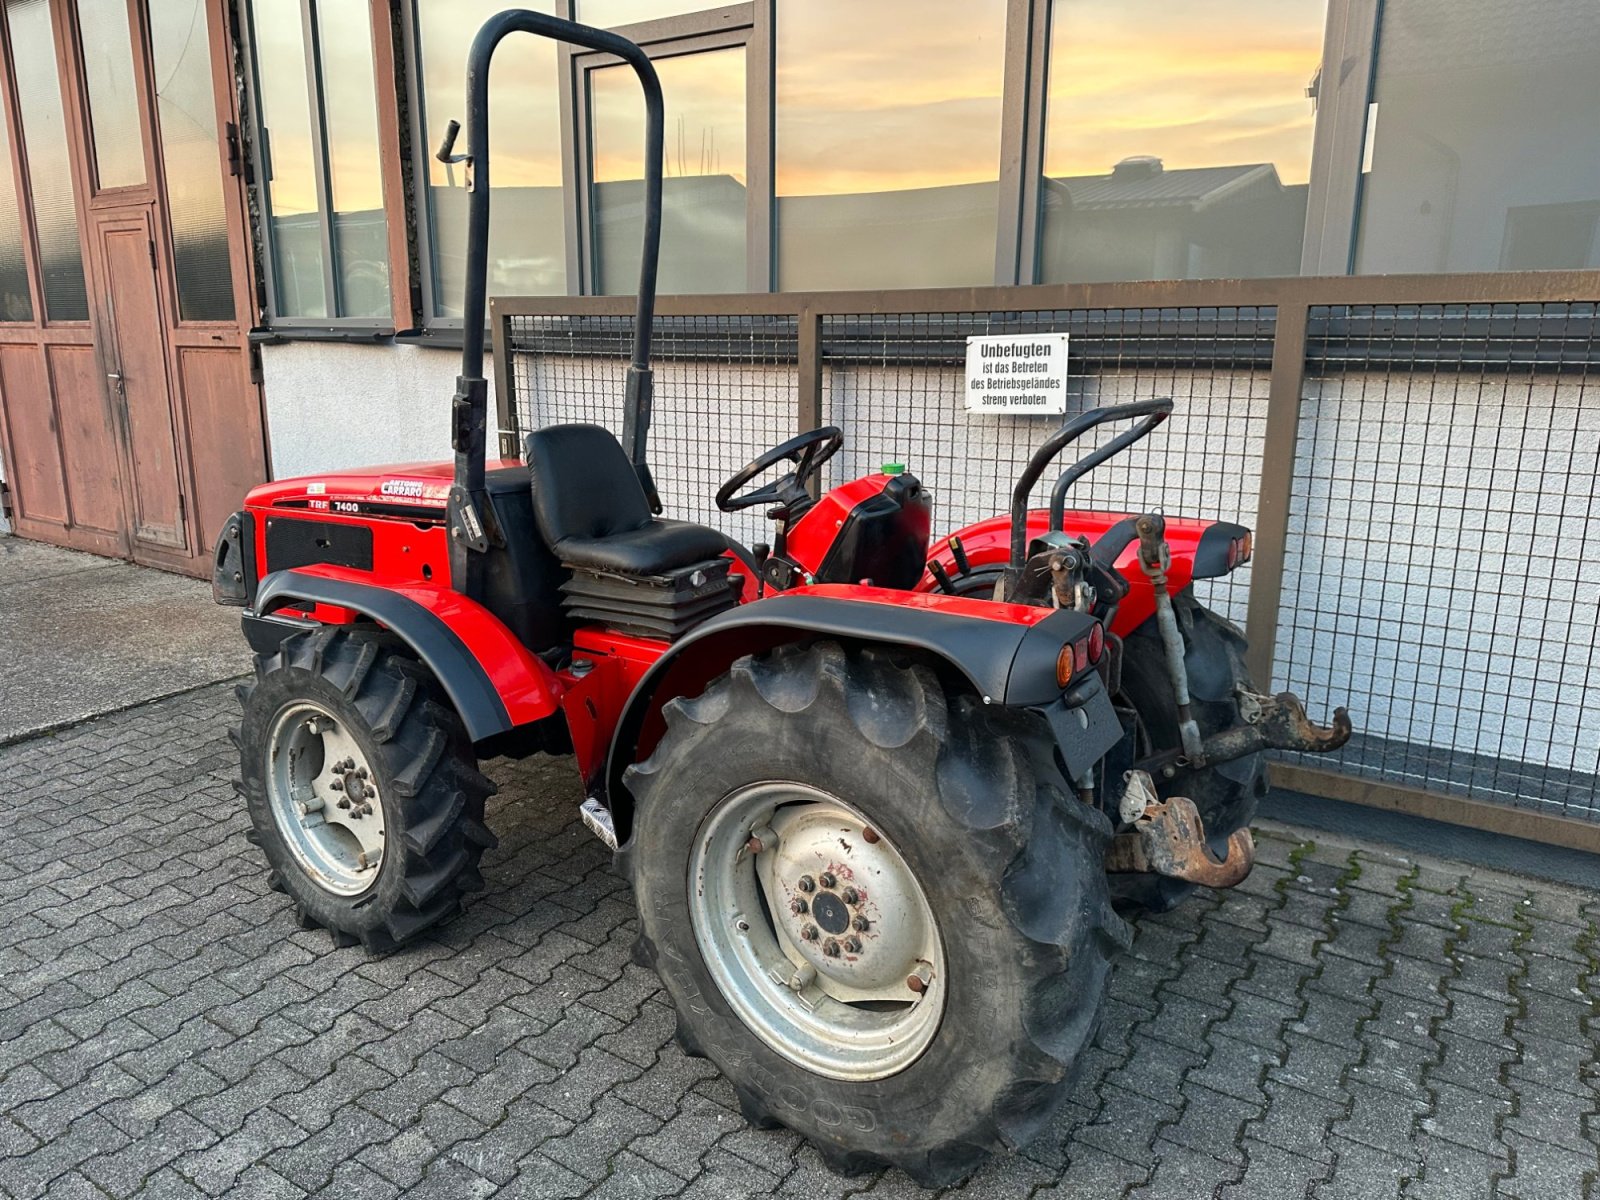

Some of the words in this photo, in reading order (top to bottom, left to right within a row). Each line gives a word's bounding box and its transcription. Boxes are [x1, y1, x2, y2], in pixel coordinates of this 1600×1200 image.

[981, 343, 1051, 358] Unbefugten
[982, 362, 993, 374] ist
[995, 362, 1009, 373] das
[1012, 361, 1048, 373] Betreten
[971, 378, 985, 390] des
[987, 377, 1061, 390] Betriebsgeländes
[982, 394, 1007, 406] streng
[1010, 393, 1047, 405] verboten
[381, 482, 422, 497] CARRARO
[390, 479, 423, 488] ANTONIO
[309, 499, 328, 510] TRF
[334, 501, 359, 513] 7400
